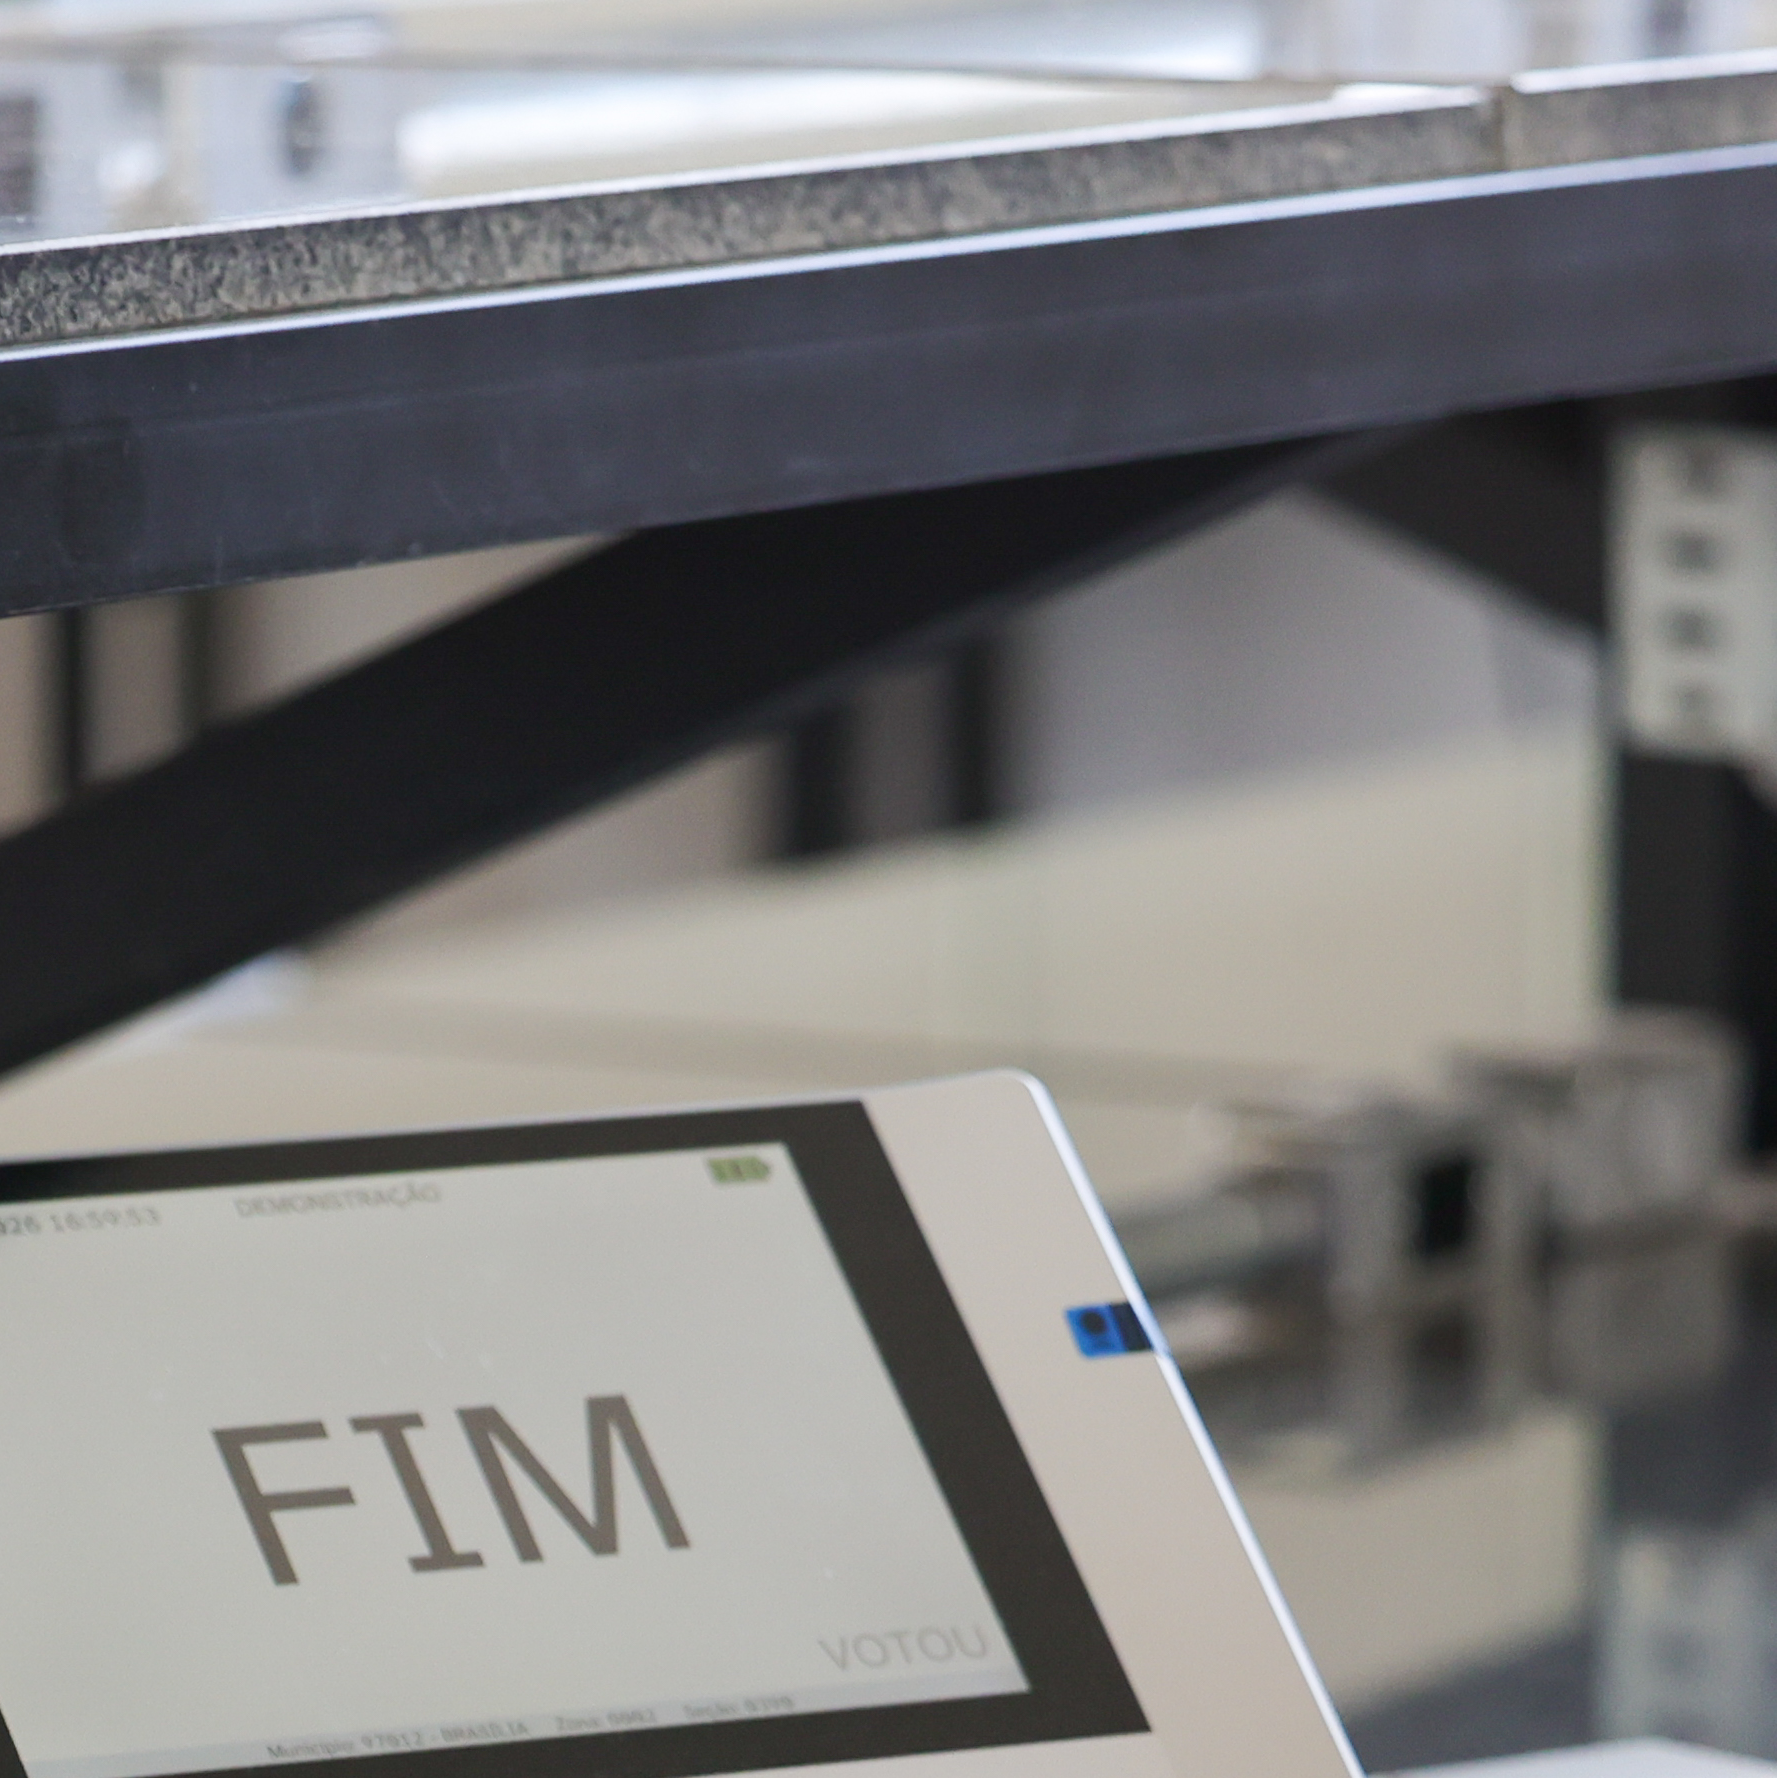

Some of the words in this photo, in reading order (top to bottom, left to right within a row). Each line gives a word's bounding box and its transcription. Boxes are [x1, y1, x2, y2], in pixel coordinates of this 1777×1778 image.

[234, 1180, 441, 1218] DEMONSTRAÇÃO
[211, 1393, 691, 1587] FIM
[818, 1625, 987, 1672] VOTOU
